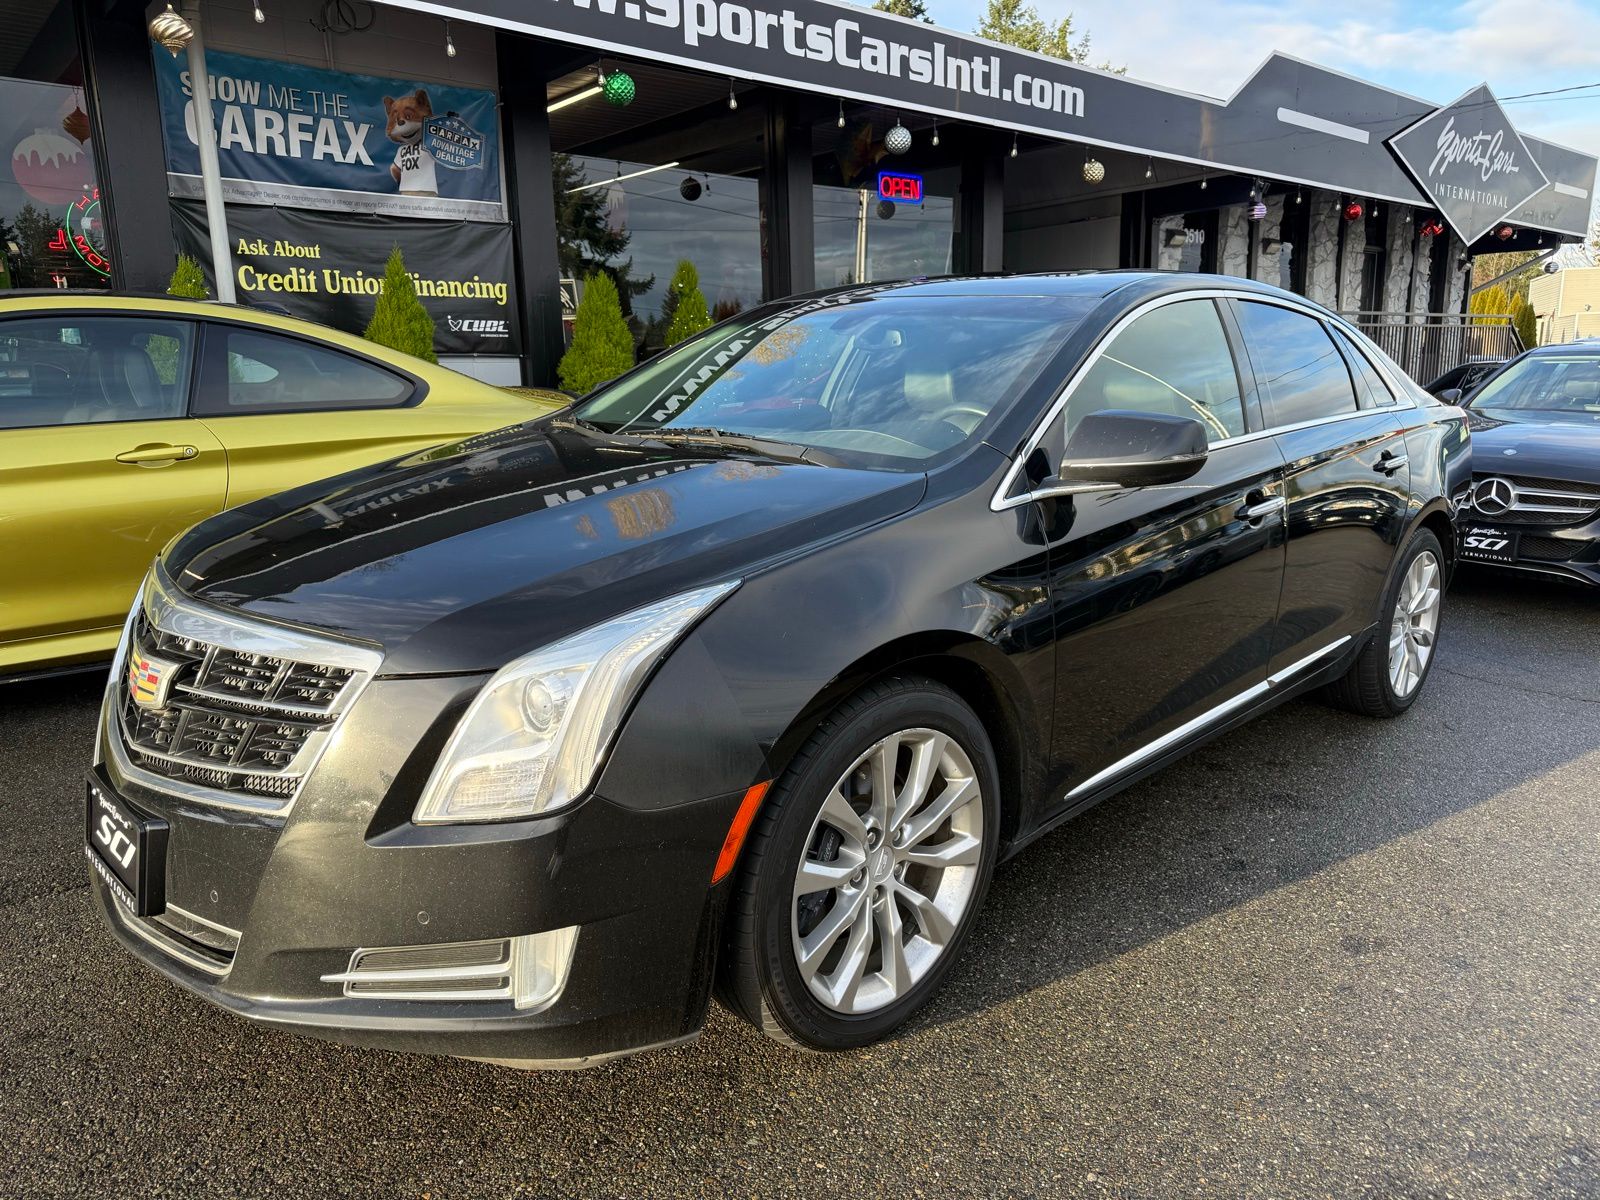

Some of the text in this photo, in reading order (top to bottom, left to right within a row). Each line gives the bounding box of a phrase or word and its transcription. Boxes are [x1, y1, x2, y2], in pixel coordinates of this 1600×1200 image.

[268, 84, 304, 112] ME
[307, 90, 350, 119] THE
[428, 124, 480, 151] CARFAX
[431, 138, 475, 159] ADVANTAGE
[401, 156, 420, 172] FOX
[435, 149, 466, 167] DEALER
[880, 175, 920, 200] OPEN
[1434, 182, 1509, 209] INTERNATIONAL
[237, 238, 321, 259] Ask About
[237, 264, 318, 293] Credit
[404, 272, 508, 306] inancing
[1463, 536, 1510, 551] SCI
[96, 814, 137, 869] SCI
[84, 845, 136, 913] INTERNATIONAL
